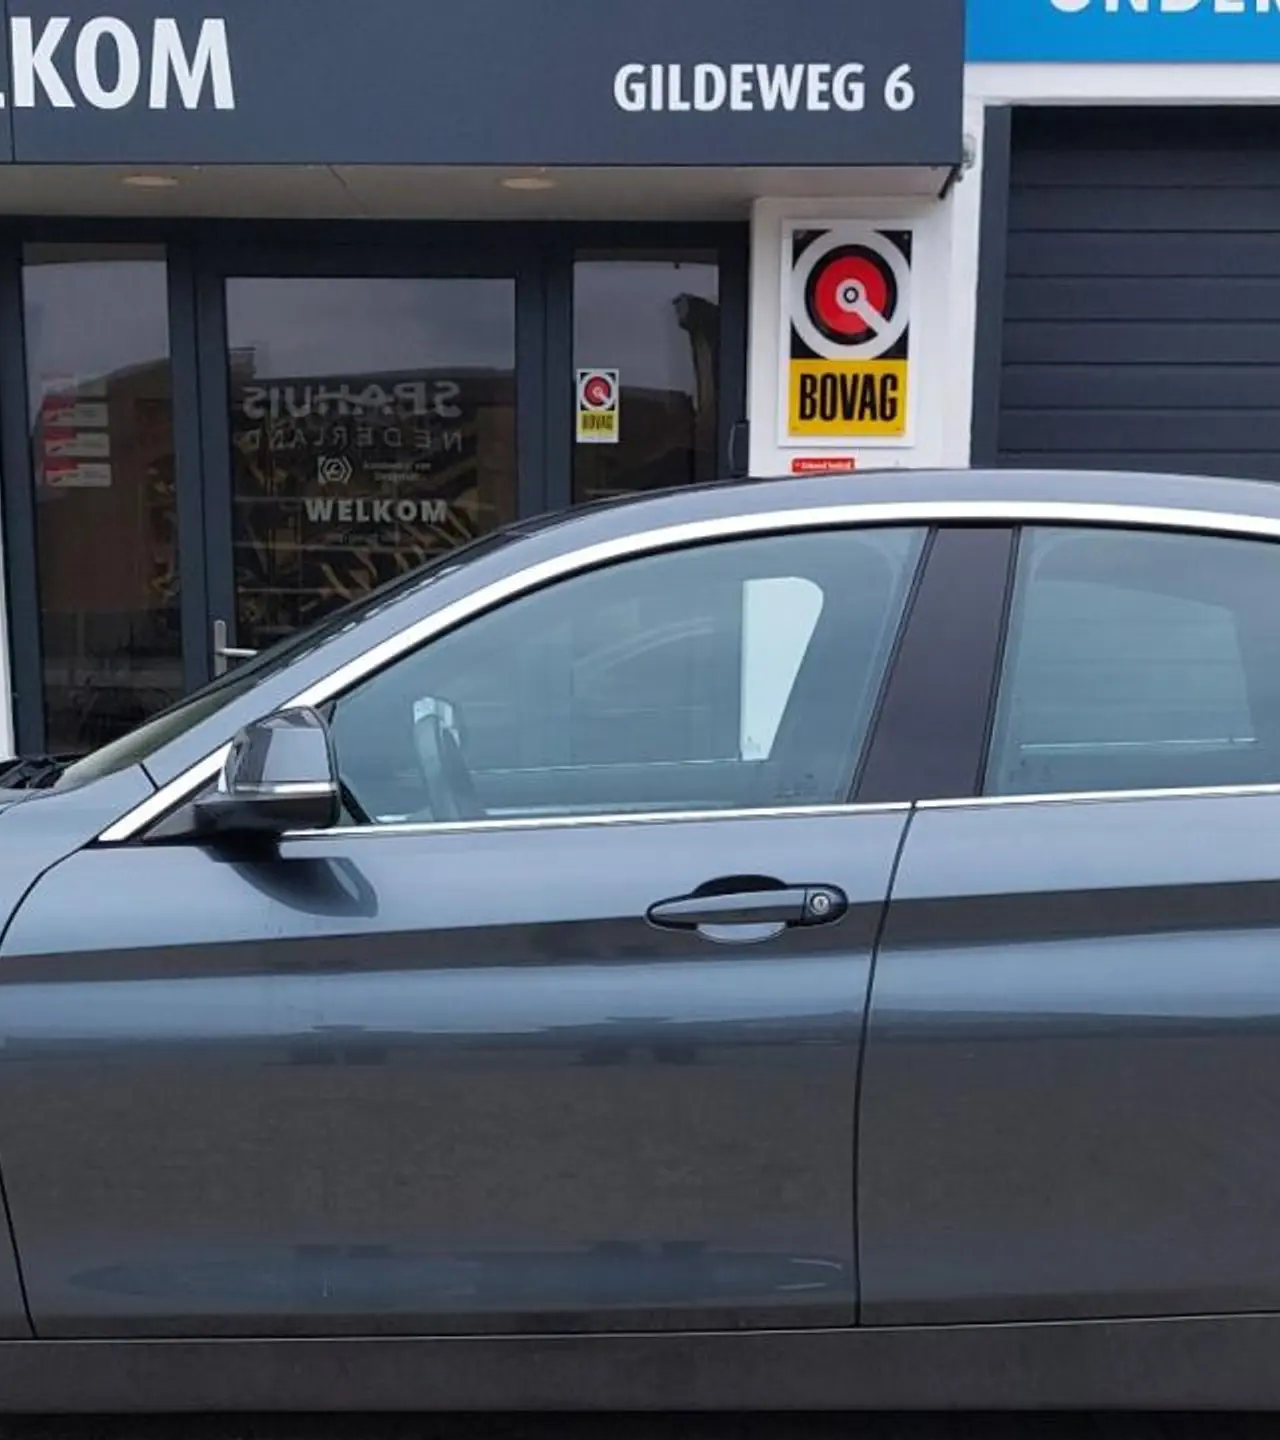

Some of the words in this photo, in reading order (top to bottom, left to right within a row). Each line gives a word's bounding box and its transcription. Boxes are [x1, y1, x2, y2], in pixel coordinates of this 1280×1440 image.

[613, 62, 866, 112] GILDEWEG
[883, 63, 915, 112] 6
[799, 373, 898, 422] BOVAG
[303, 497, 449, 523] WELKOM
